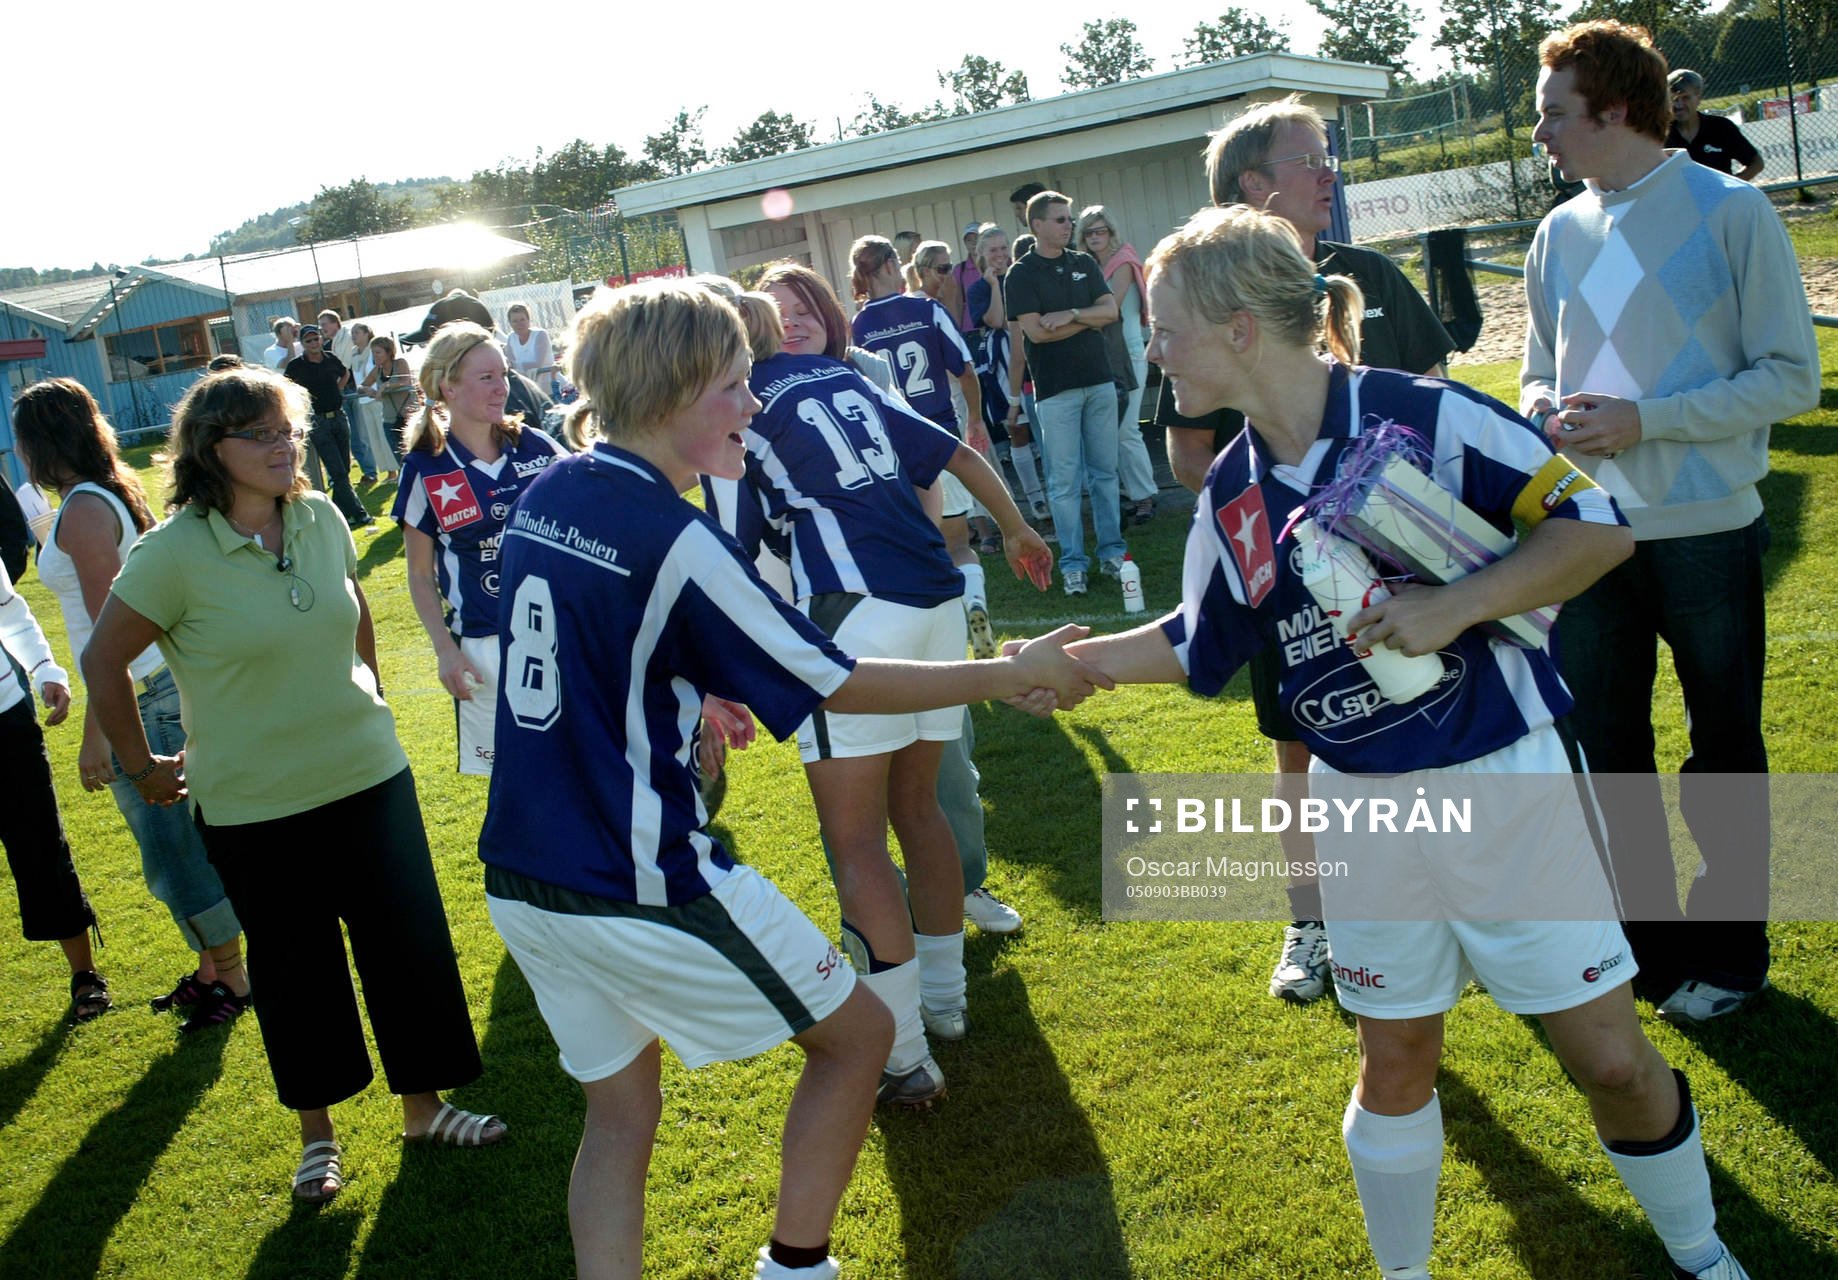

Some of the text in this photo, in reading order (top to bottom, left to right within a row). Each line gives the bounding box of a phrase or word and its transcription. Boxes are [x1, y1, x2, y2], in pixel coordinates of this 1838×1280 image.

[759, 366, 850, 401] Mölndals-Posten
[797, 389, 900, 491] 13
[442, 505, 477, 527] MATCH
[514, 510, 619, 563] Mölndals-Posten
[1277, 604, 1334, 643] MÖL
[505, 573, 562, 732] 8
[1301, 688, 1381, 726] CCsp
